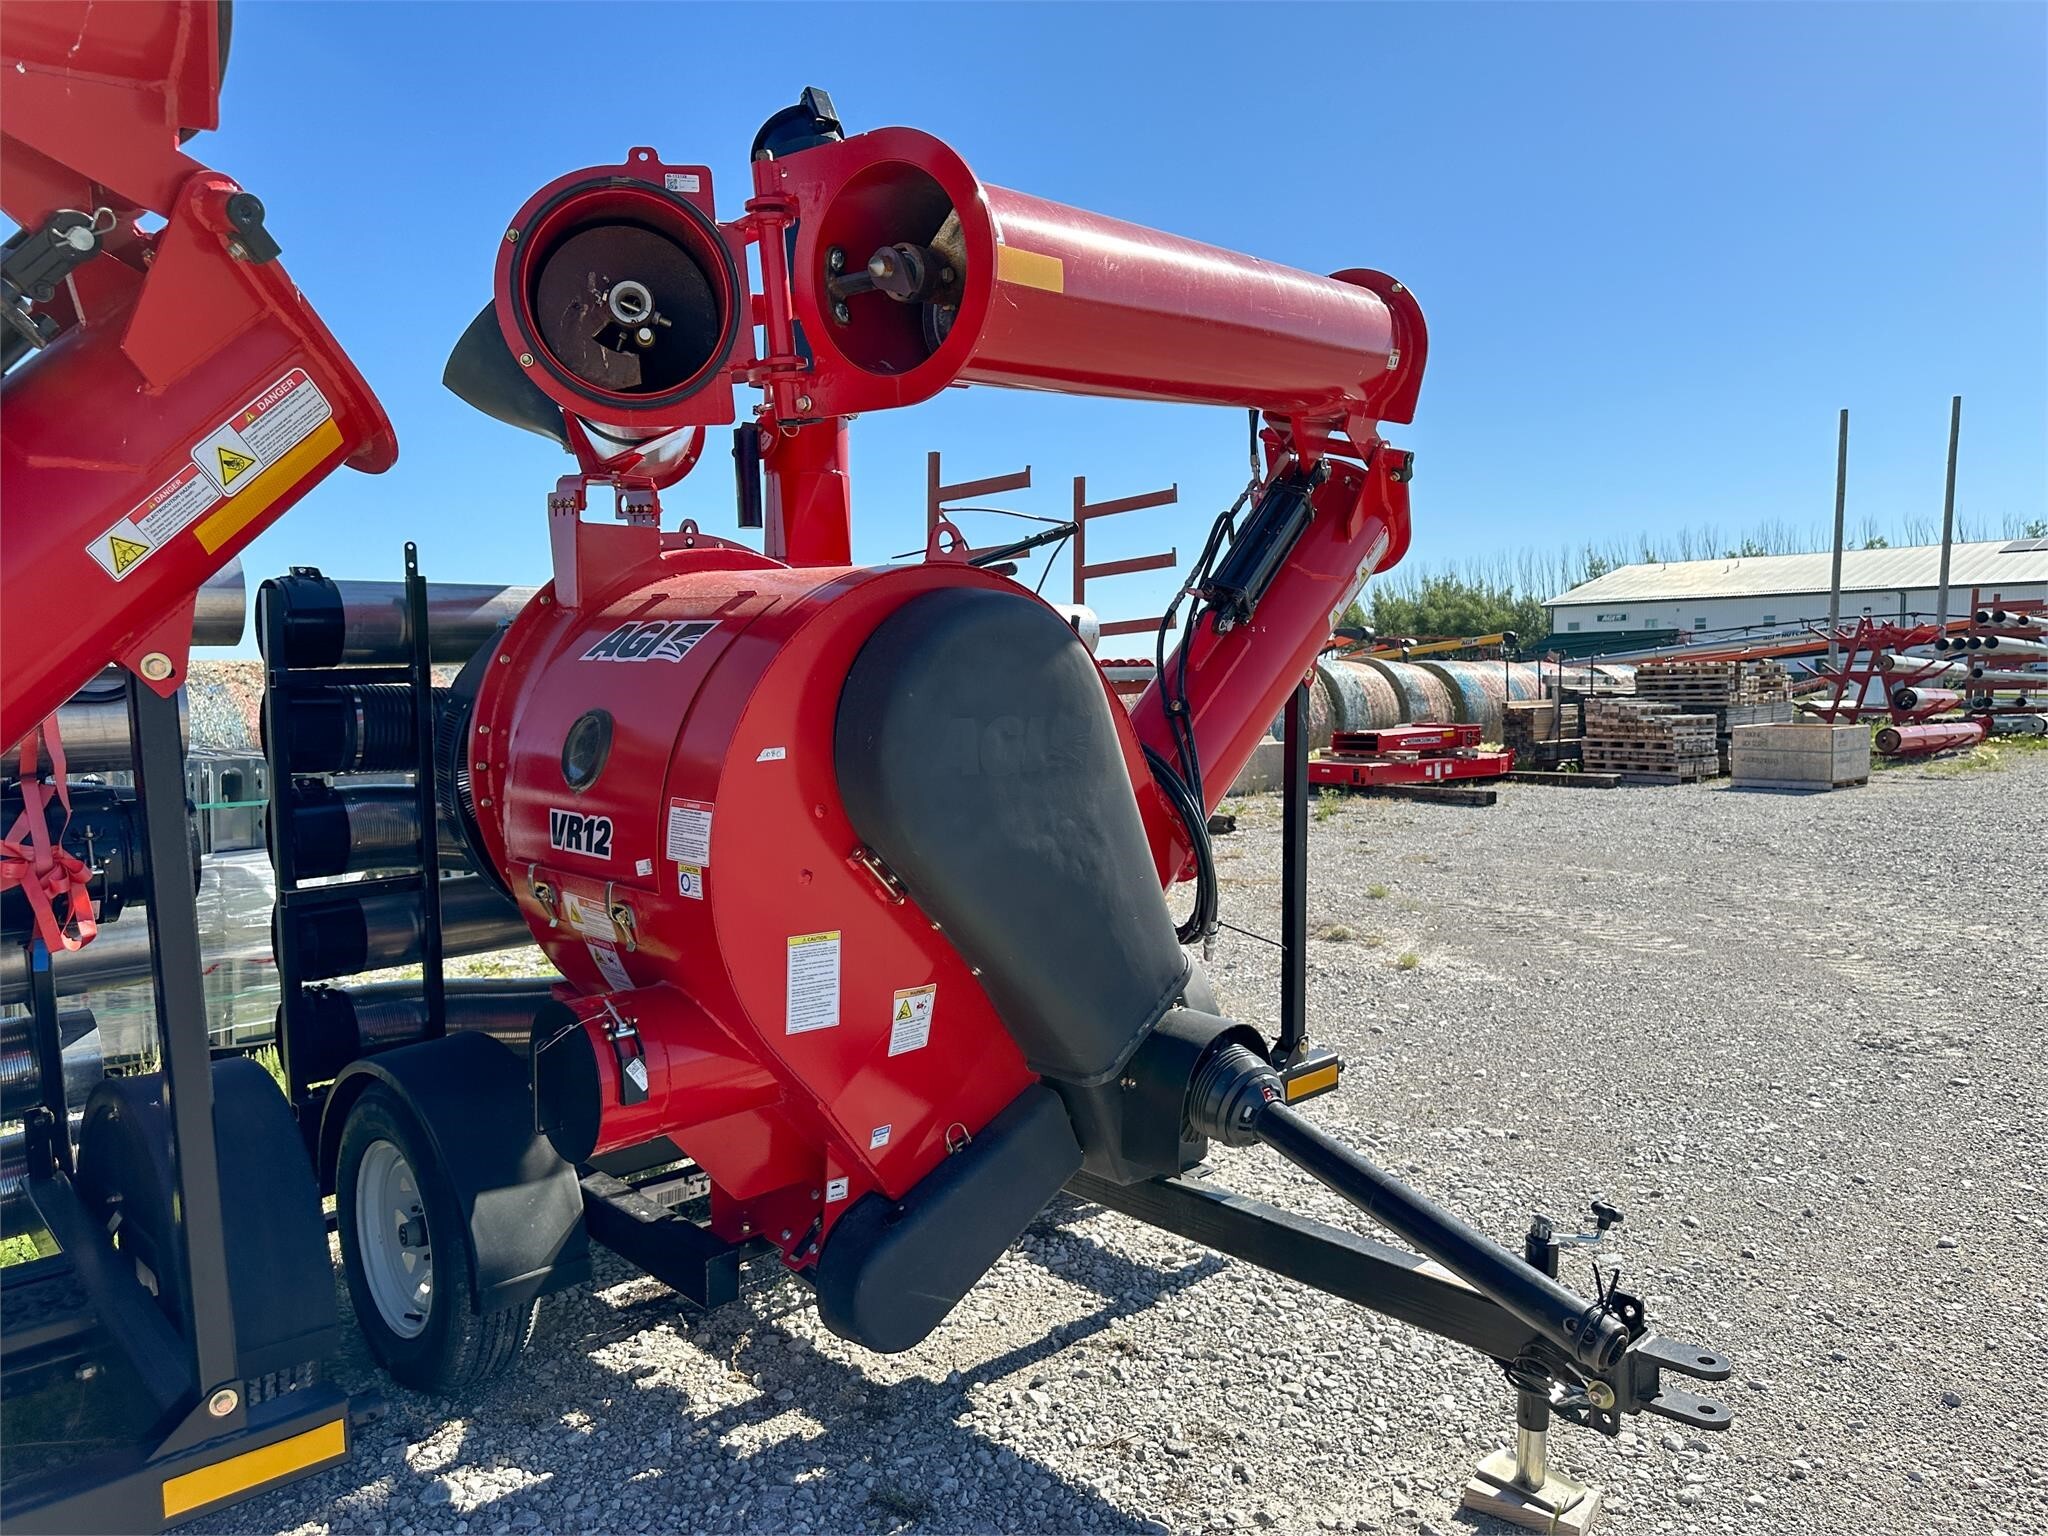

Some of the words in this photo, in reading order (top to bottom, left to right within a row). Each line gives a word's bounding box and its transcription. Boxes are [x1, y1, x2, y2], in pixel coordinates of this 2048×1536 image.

[256, 377, 296, 411] DANGER
[153, 478, 183, 503] DANGER
[584, 622, 684, 660] AGI
[551, 811, 612, 857] VR12
[807, 934, 828, 943] CAUTION
